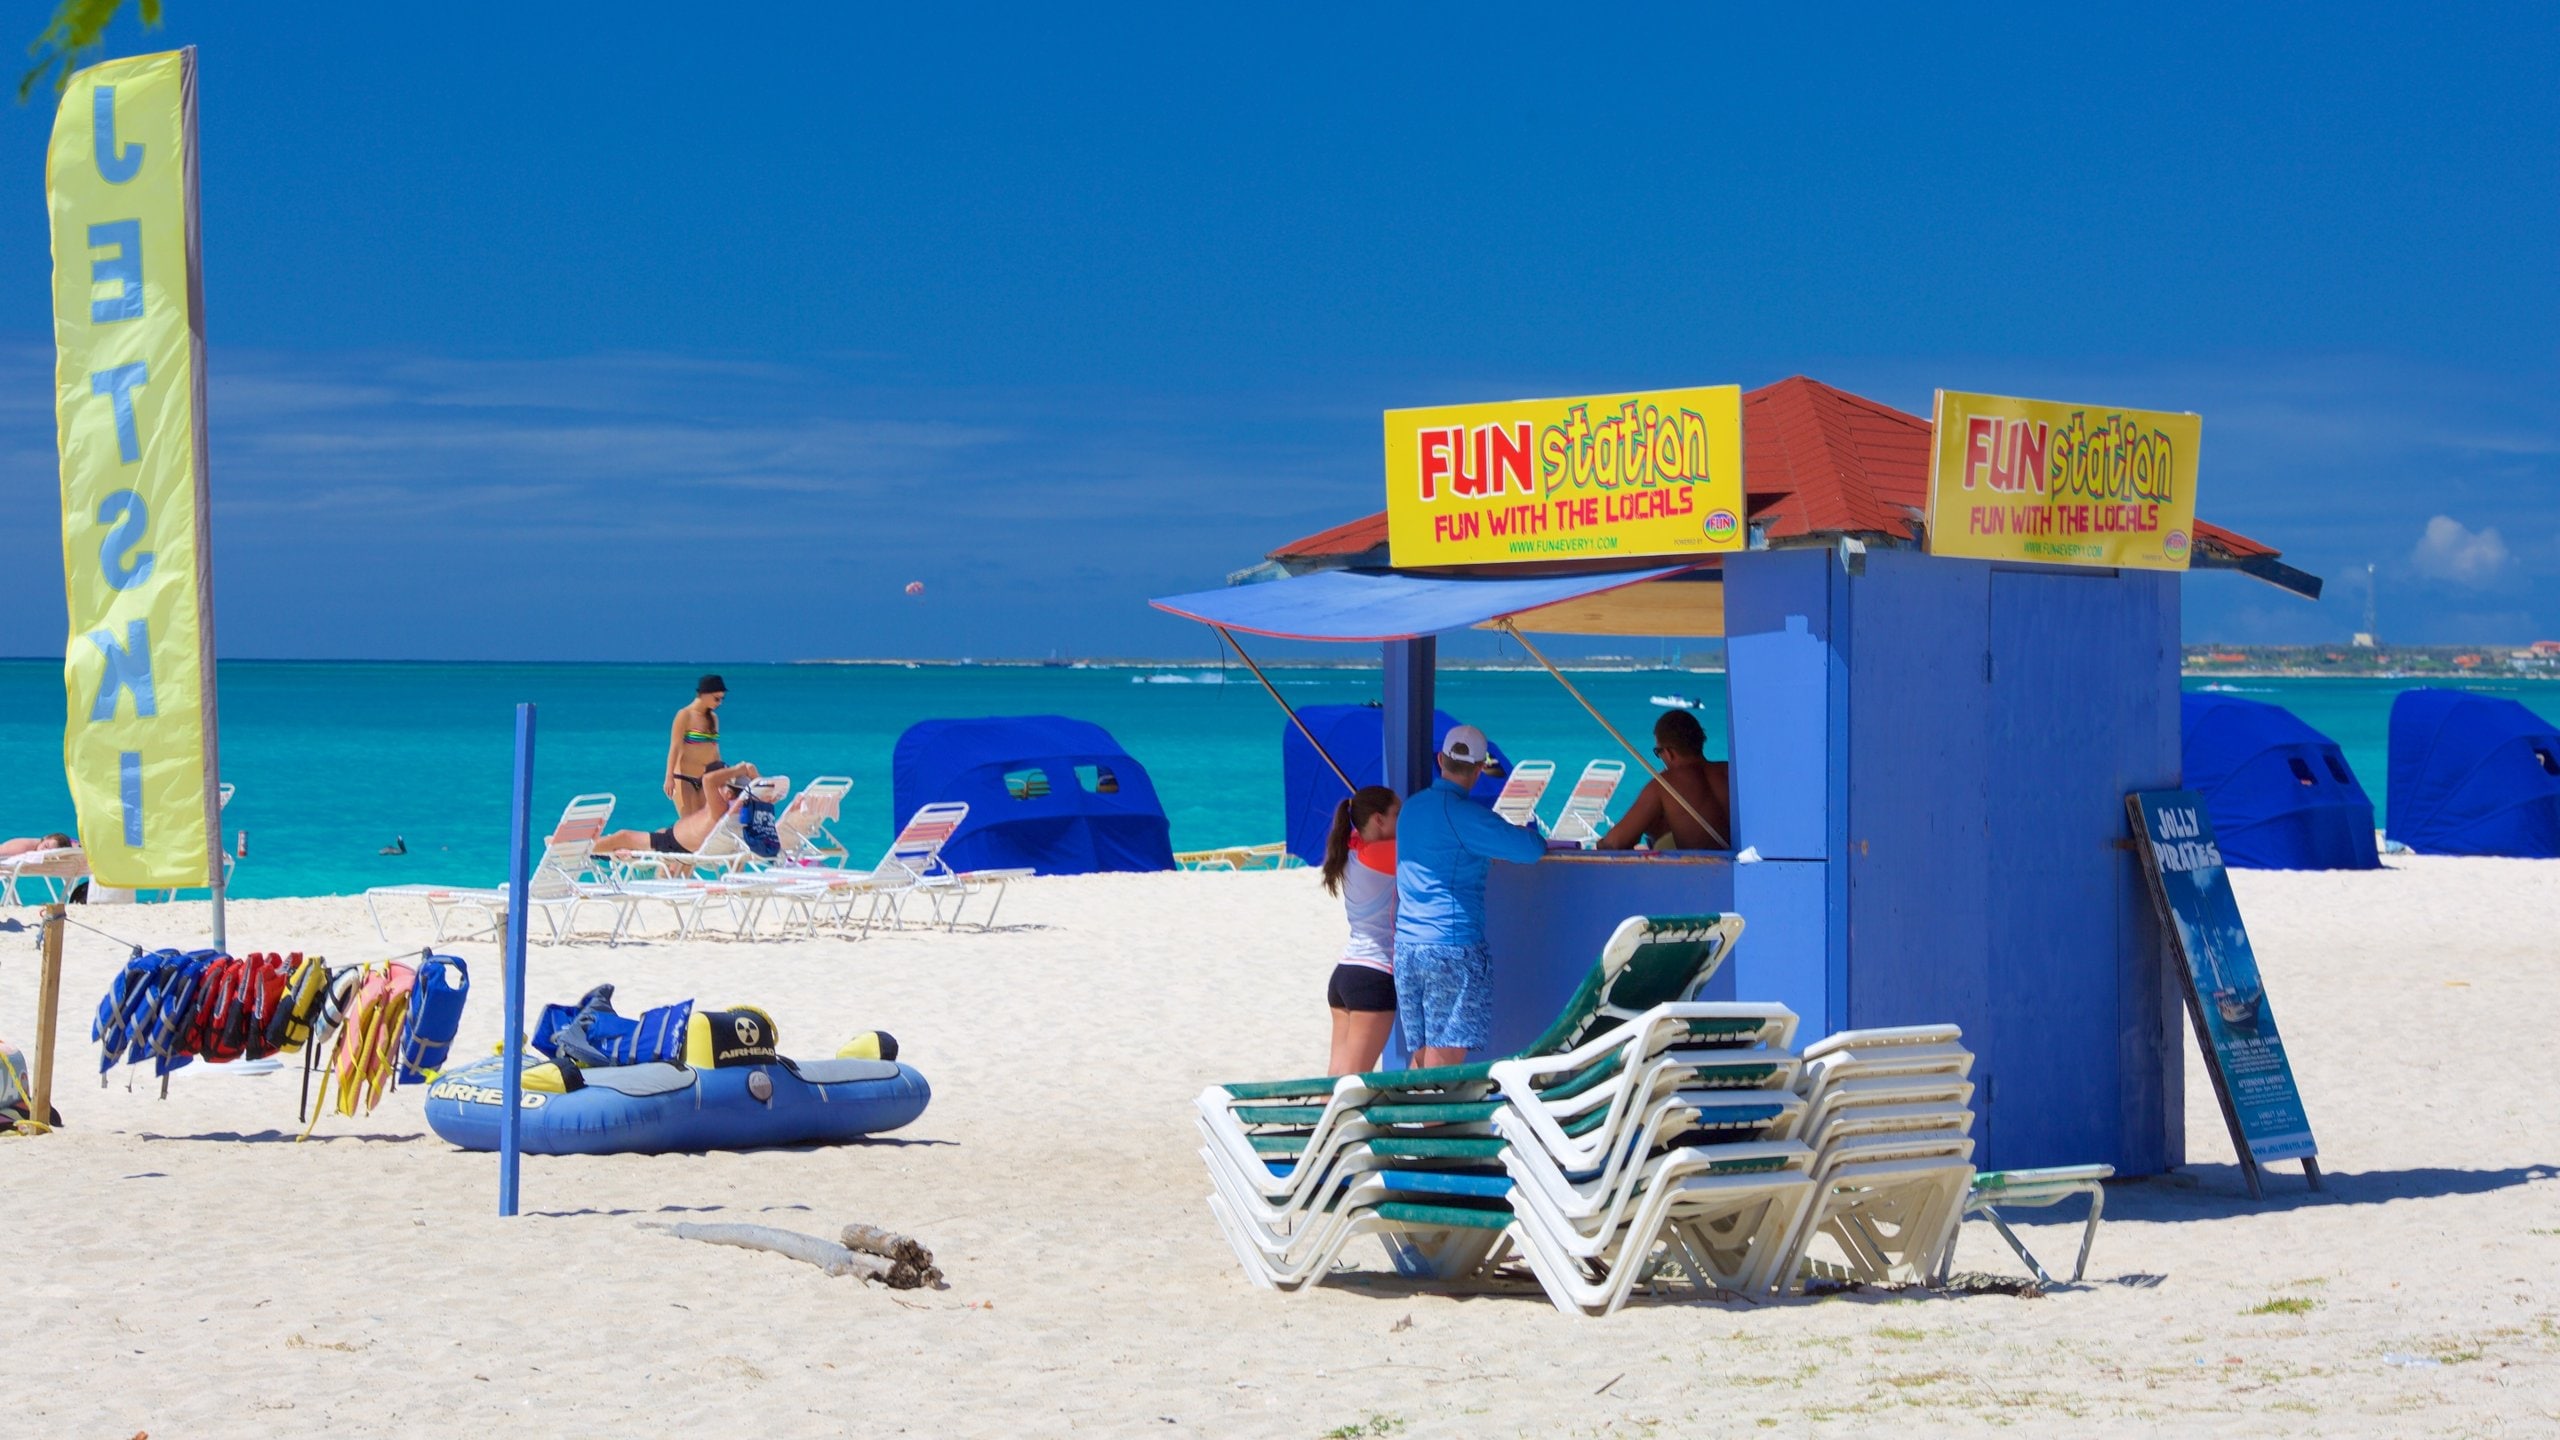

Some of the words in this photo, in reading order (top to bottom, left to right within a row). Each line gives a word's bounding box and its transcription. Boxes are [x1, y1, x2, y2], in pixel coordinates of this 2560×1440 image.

[1418, 421, 1533, 502] FUN
[1540, 400, 1710, 499] station
[1962, 414, 2048, 495] FUN
[2052, 411, 2173, 503] station
[1435, 511, 1479, 542] FUN
[1487, 505, 1547, 536] WITH
[1555, 498, 1598, 531] THE
[1606, 486, 1693, 524] LOCALS
[1709, 516, 1731, 531] FUN
[1970, 506, 2005, 535] FUN
[2011, 505, 2051, 536] WITH
[2057, 505, 2088, 536] THE
[2094, 504, 2159, 533] LOCALS
[1509, 536, 1618, 554] WWW.FUN4EVERY1.COM
[2157, 807, 2200, 839] JOLLY
[2152, 841, 2222, 873] PIRATES
[719, 1047, 776, 1060] AIRHEAD
[431, 1082, 548, 1110] AIRHED
